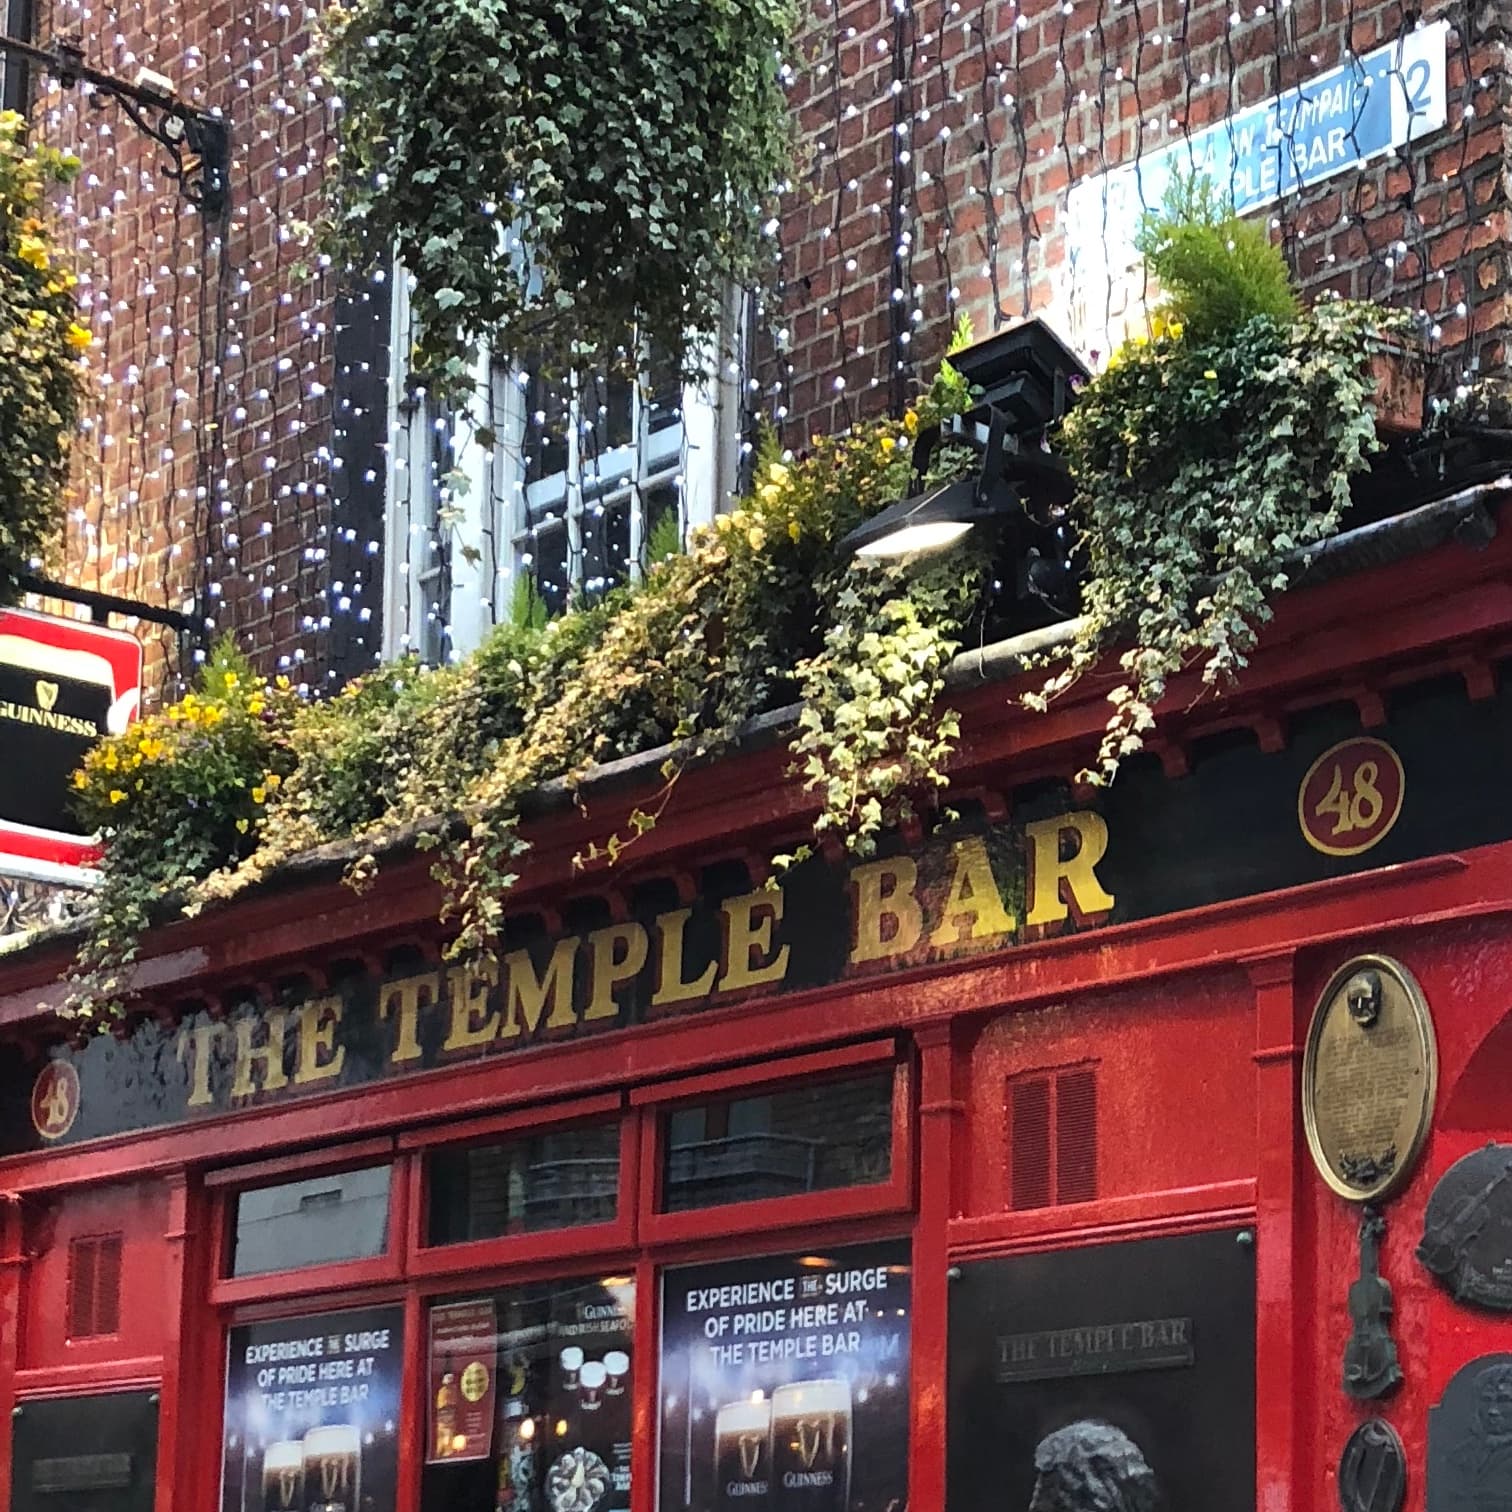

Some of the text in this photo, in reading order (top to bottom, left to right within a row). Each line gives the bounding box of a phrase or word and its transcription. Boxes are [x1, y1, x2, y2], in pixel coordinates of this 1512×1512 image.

[1405, 58, 1432, 112] 2
[1290, 127, 1346, 178] BAR
[1315, 760, 1384, 836] 48
[178, 809, 1116, 1106] THE TEMPLE BAR
[46, 1077, 71, 1126] 48
[686, 1278, 796, 1312] EXPERIENCE
[825, 1266, 888, 1296] SURGE
[704, 1299, 867, 1339] OF PRIDE HERE AT
[1141, 1320, 1187, 1348] BAR
[245, 1336, 325, 1364] EXPERIENCE
[344, 1329, 391, 1352] SURGE
[709, 1331, 861, 1367] THE TEMPLE BAR
[257, 1357, 375, 1387] OF PRIDE HERE AT
[261, 1383, 369, 1411] THE TEMPLE BAR
[783, 1469, 834, 1490] GUINNESS
